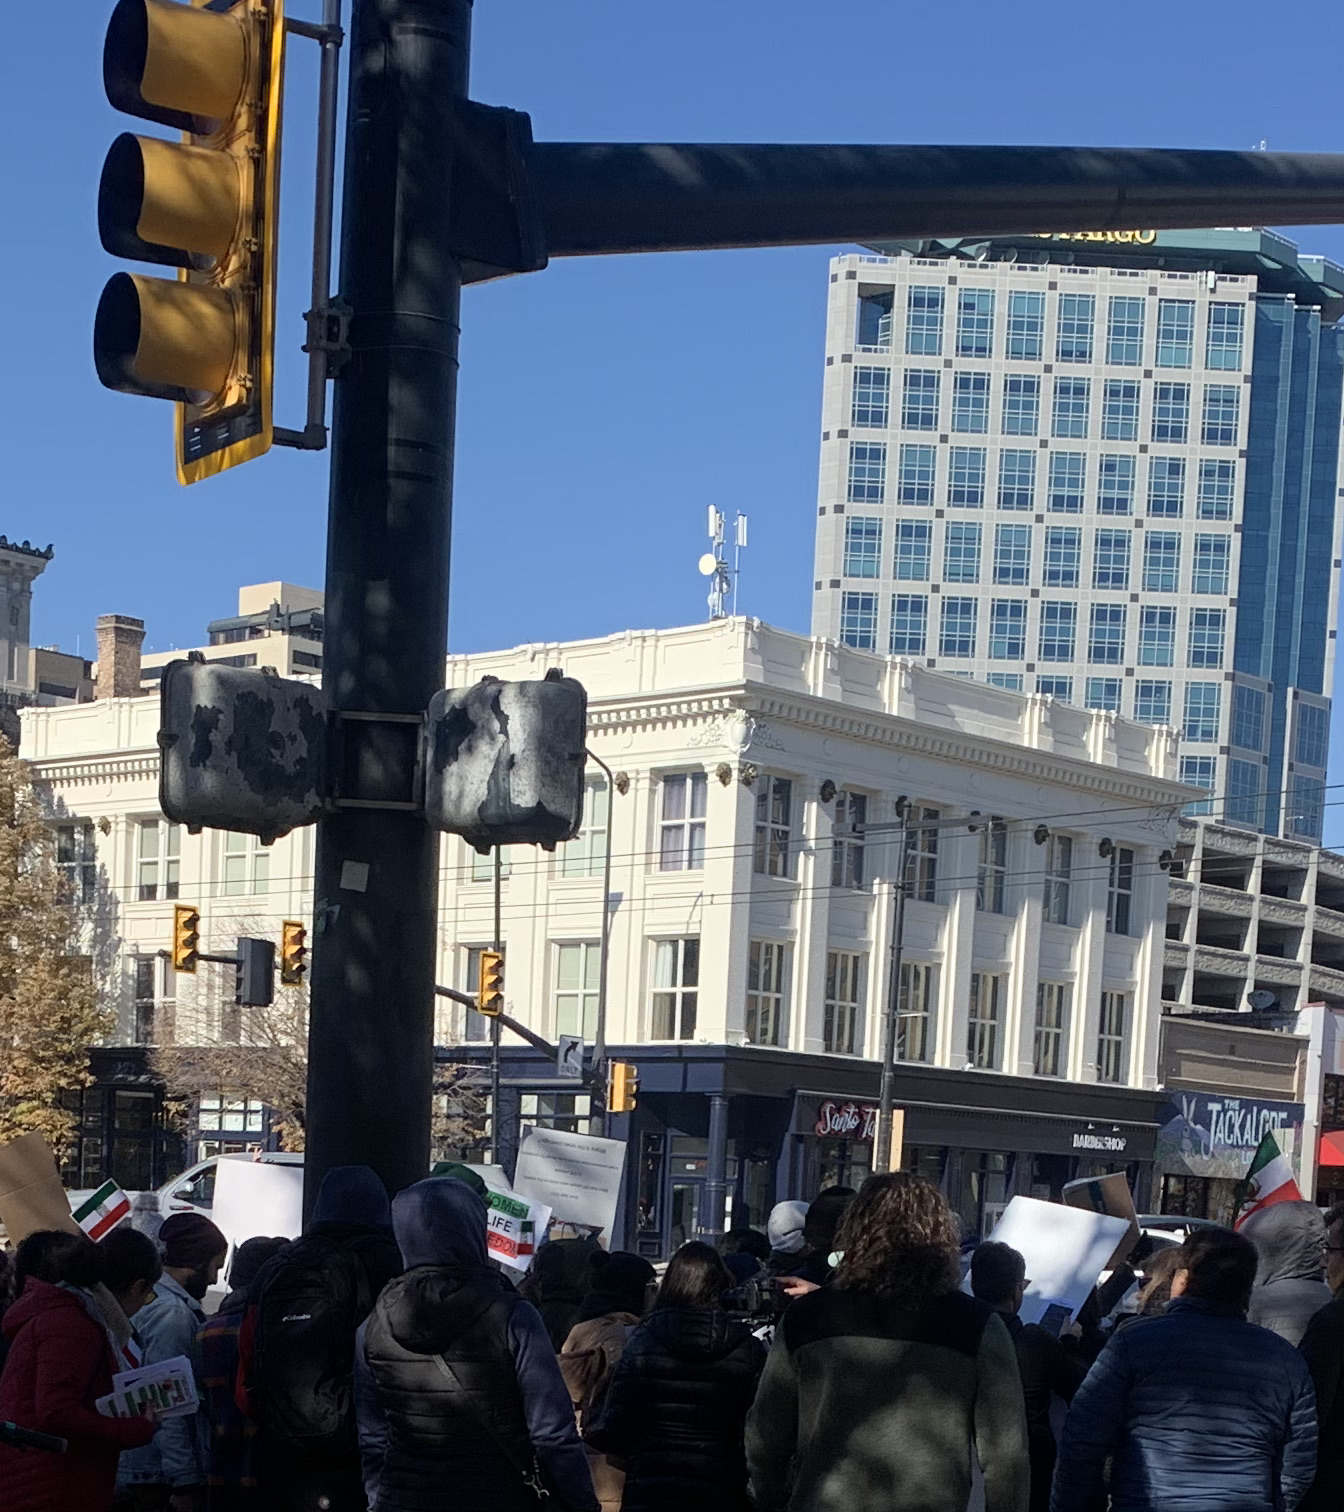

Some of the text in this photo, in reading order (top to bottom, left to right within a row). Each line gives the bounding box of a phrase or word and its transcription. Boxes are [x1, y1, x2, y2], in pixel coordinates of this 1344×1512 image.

[560, 1064, 578, 1074] ONLY
[1224, 1099, 1240, 1109] THE
[819, 1103, 860, 1133] Santo
[1073, 1134, 1126, 1150] BARBERSHOP
